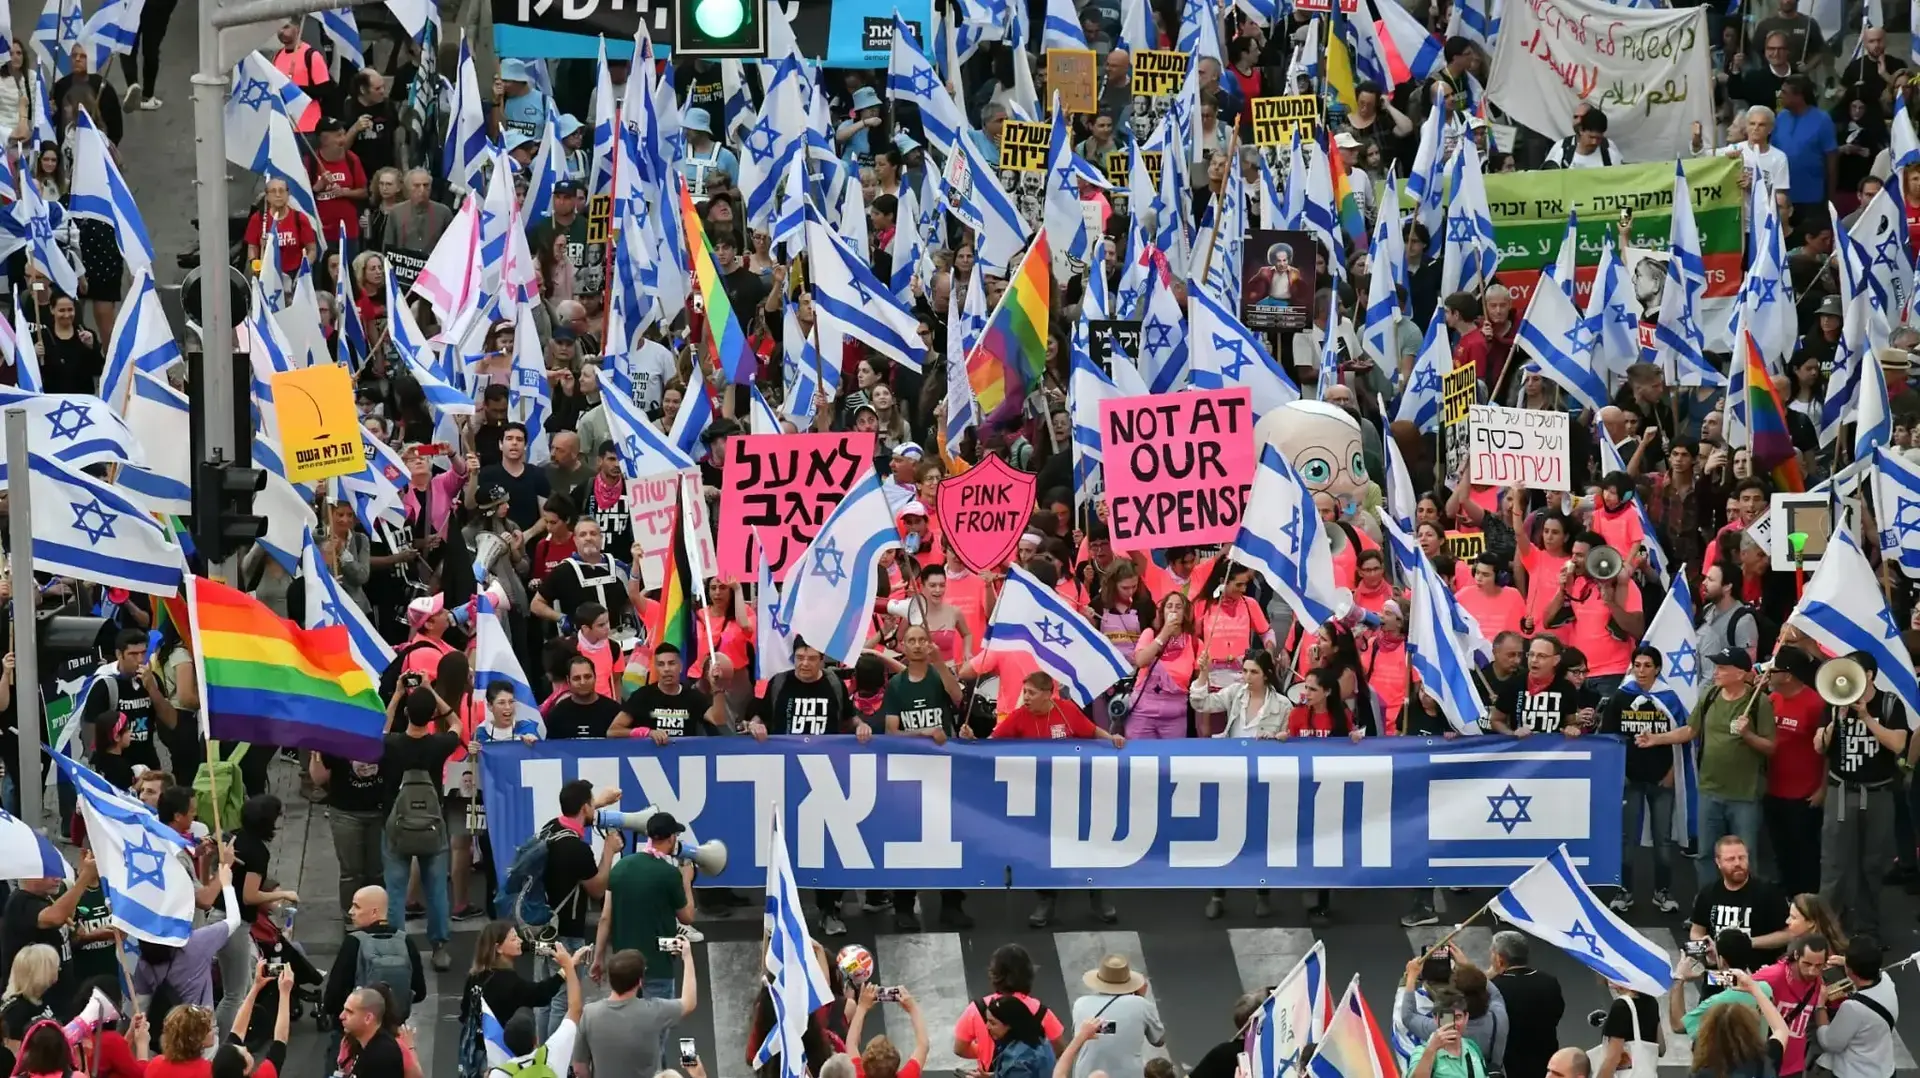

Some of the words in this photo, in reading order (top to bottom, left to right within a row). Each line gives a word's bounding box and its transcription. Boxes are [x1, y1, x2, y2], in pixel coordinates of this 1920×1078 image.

[1595, 22, 1625, 56] לא
[1255, 98, 1315, 119] ממשלת
[1003, 143, 1050, 169] ביזה
[1593, 189, 1674, 211] מוקרטיה
[1694, 185, 1722, 206] אין
[1488, 201, 1527, 216] זכוי
[1535, 199, 1563, 218] אין
[387, 251, 427, 268] מוקרטיה
[1496, 240, 1530, 263] حقو
[395, 265, 421, 280] יבוש
[1110, 405, 1181, 445] NOT
[1190, 397, 1246, 434] AT
[1471, 408, 1496, 425] זהב
[1501, 407, 1520, 425] של
[1525, 411, 1567, 428] ירושלים
[322, 443, 339, 457] לא
[341, 441, 354, 454] זה
[1477, 427, 1524, 454] כסף
[1534, 430, 1563, 451] ושל
[296, 448, 321, 464] גשם
[735, 439, 799, 490] על
[805, 437, 862, 491] לא
[1130, 441, 1228, 482] OUR
[1474, 452, 1561, 483] ושחיתות
[631, 473, 700, 507] דרשות
[961, 483, 1013, 507] PINK
[955, 509, 1020, 533] FRONT
[794, 697, 829, 716] דמו
[1525, 690, 1562, 711] דמו
[656, 716, 685, 728] גאה
[790, 715, 828, 736] קרט
[900, 707, 943, 729] NEVER
[1654, 721, 1668, 734] אין
[1845, 735, 1880, 758] קרט
[1845, 754, 1863, 772] יה
[520, 753, 962, 870] בארצנו
[995, 755, 1393, 869] חופשי
